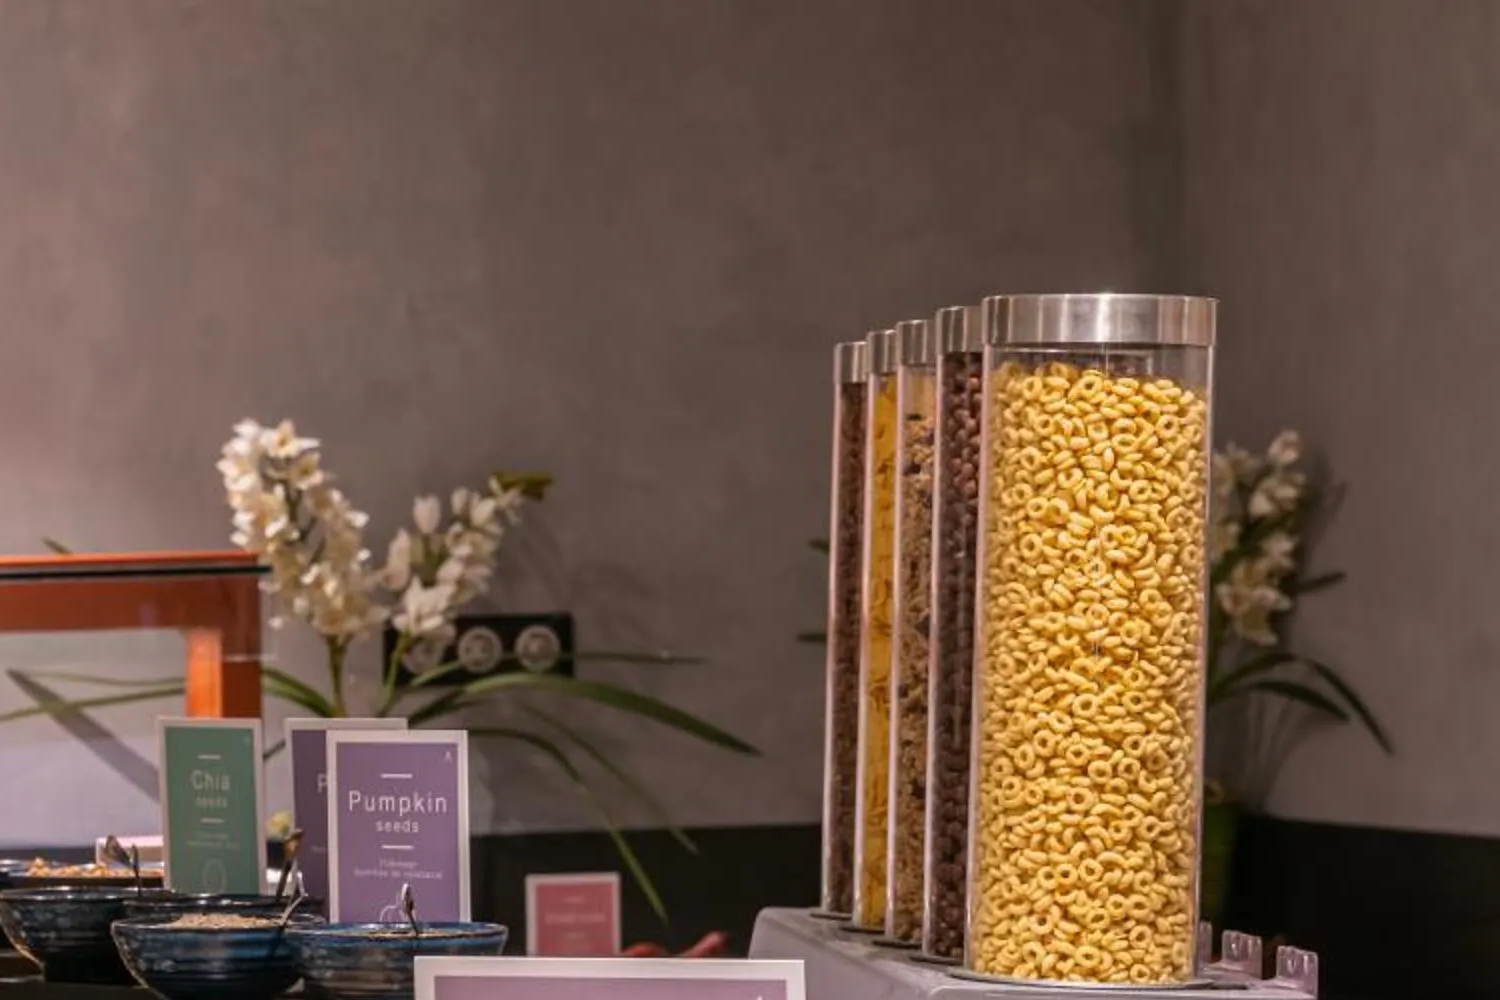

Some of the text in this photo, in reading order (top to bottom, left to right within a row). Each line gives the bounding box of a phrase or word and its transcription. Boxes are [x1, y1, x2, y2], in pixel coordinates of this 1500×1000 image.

[190, 769, 230, 791] Chia
[348, 789, 448, 817] Pumpkin
[375, 820, 419, 833] seeds
